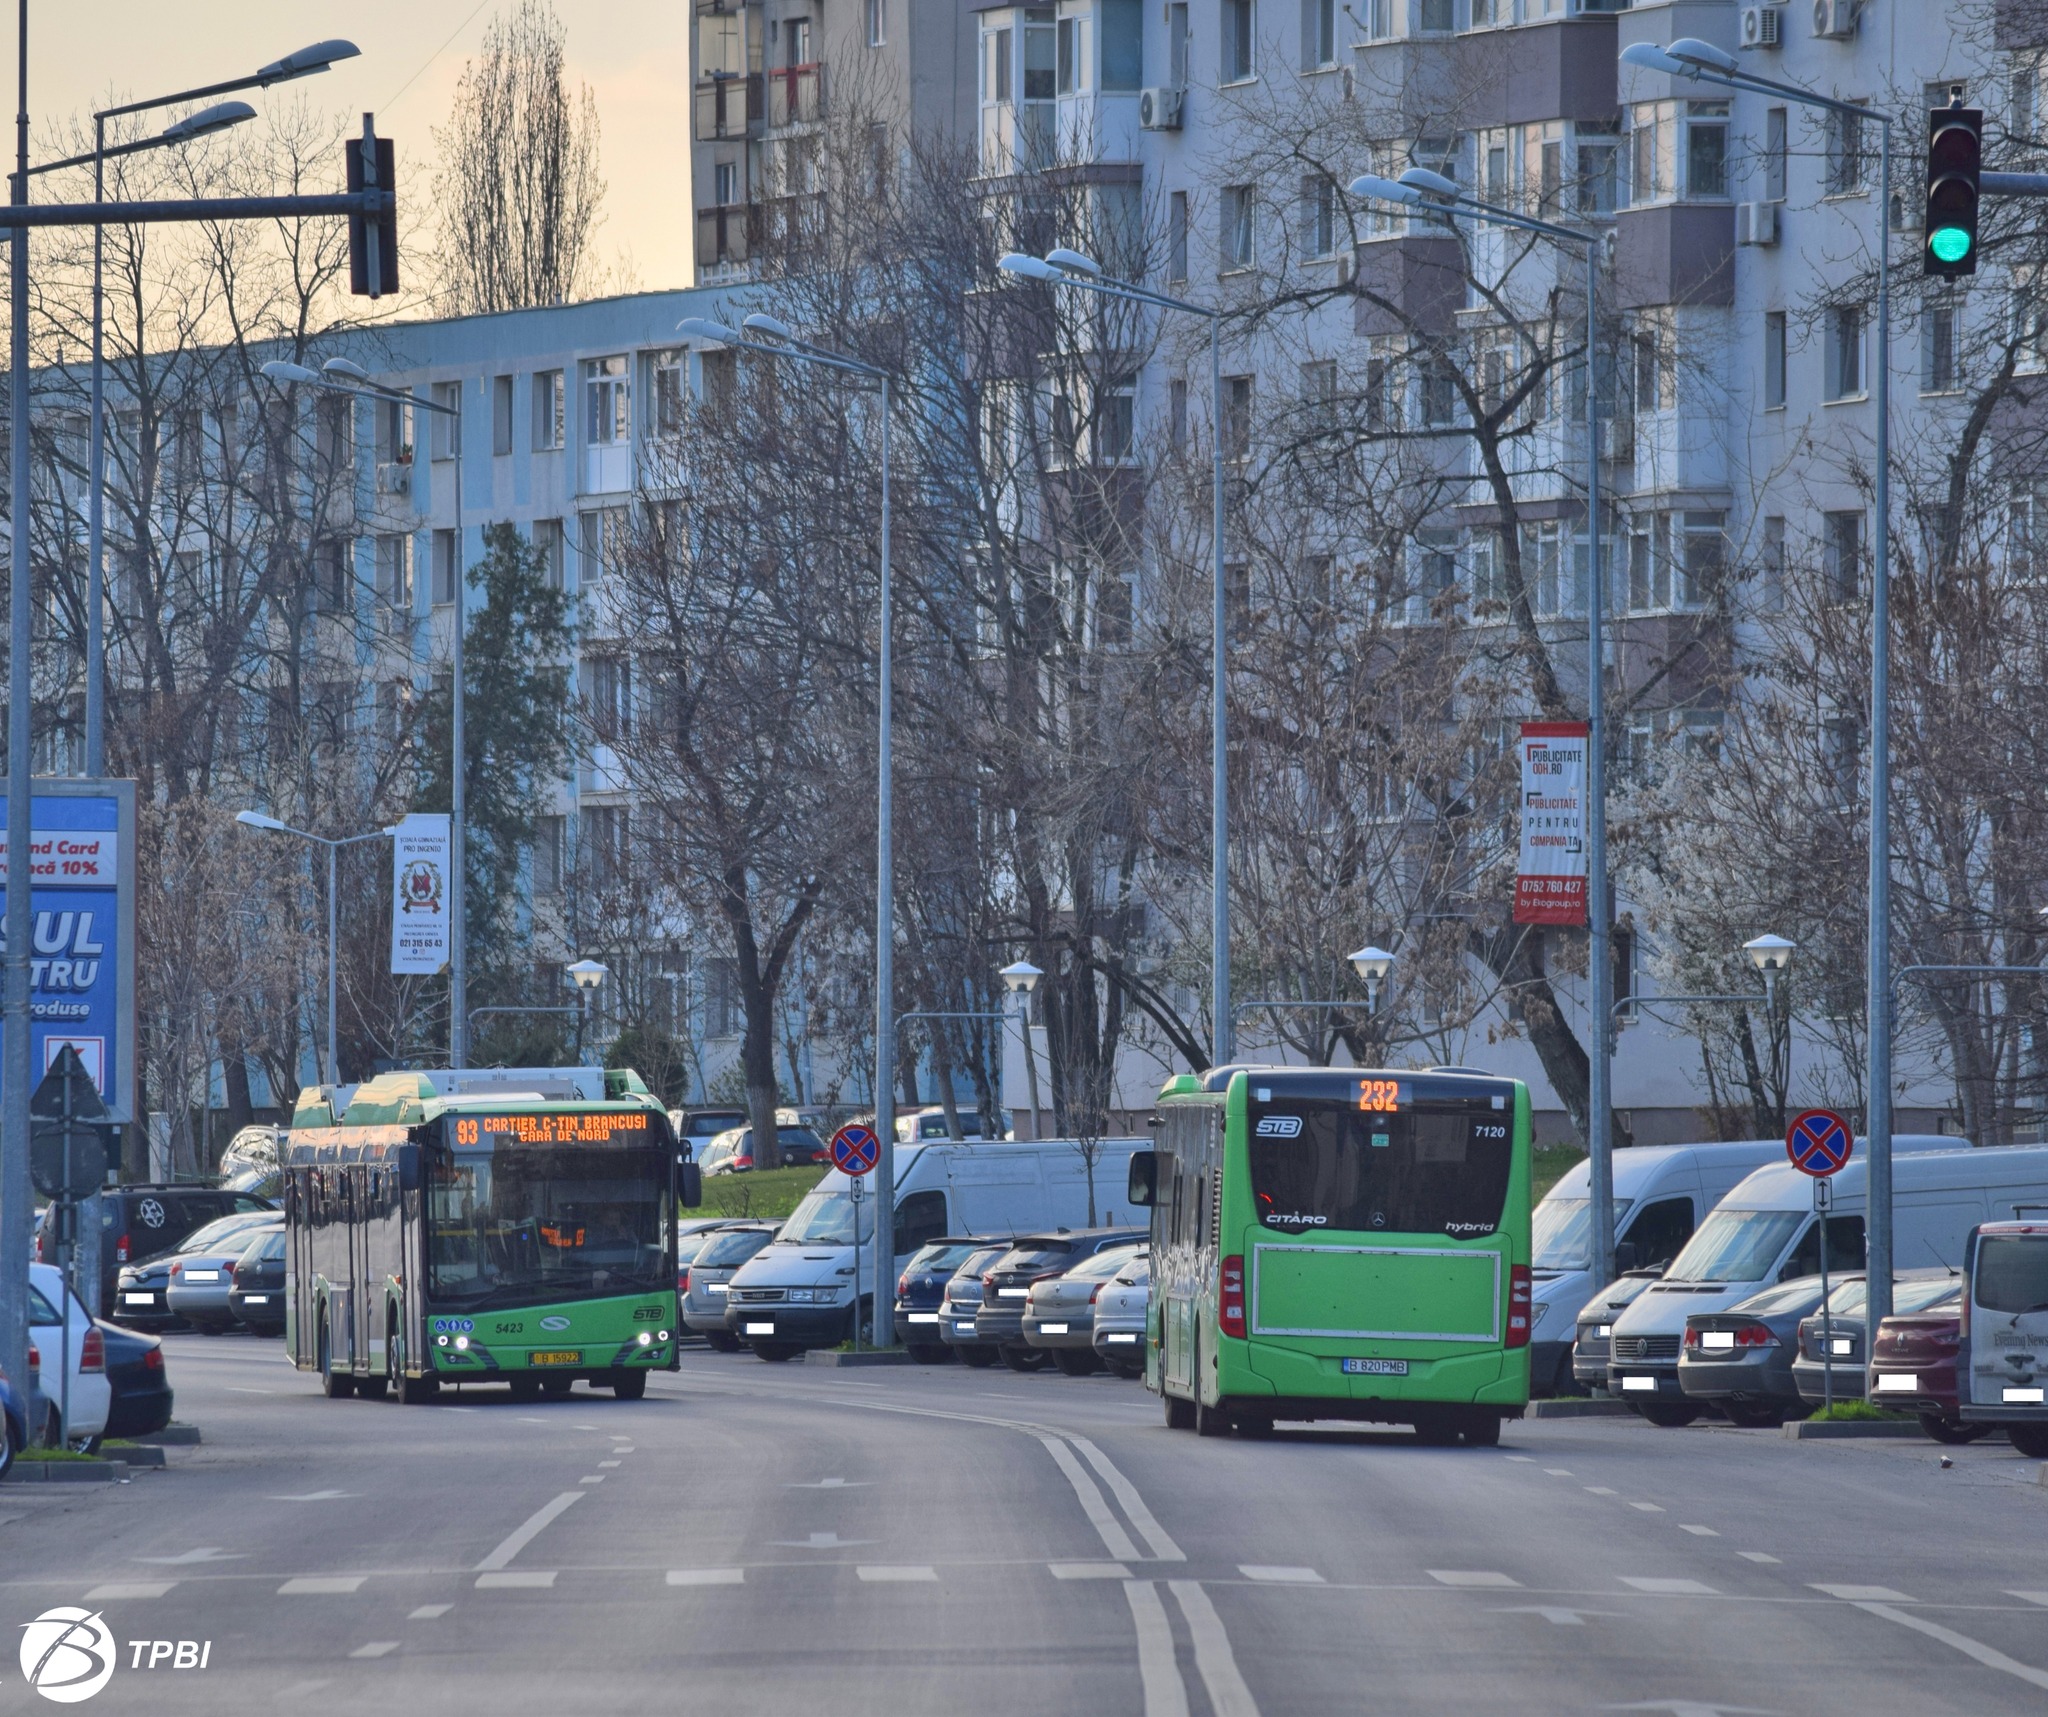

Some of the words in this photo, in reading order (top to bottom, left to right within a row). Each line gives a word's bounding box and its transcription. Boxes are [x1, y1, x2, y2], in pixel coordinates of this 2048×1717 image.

[1532, 750, 1582, 762] PUBLICITATE
[1532, 763, 1562, 775] OOH.RO
[1529, 799, 1578, 809] PUBLICITATE
[1529, 817, 1578, 828] PENTRU
[57, 841, 100, 855] Card
[1530, 836, 1567, 847] COMPANIA
[1568, 836, 1578, 847] TA
[61, 861, 98, 875] 10%
[1522, 880, 1544, 892] 0752
[1546, 881, 1562, 893] 760
[1564, 881, 1581, 893] 427
[1520, 899, 1531, 908] by
[1, 911, 103, 954] UL
[1360, 1080, 1398, 1112] 232
[484, 1117, 536, 1132] CARTIER
[543, 1116, 578, 1131] C-TIN
[584, 1115, 646, 1130] BRANCUSI
[1256, 1118, 1301, 1136] STB
[457, 1119, 478, 1145] 93
[520, 1131, 552, 1142] GARA
[558, 1130, 573, 1142] DE
[578, 1129, 610, 1141] NORD
[1475, 1125, 1505, 1138] 7120
[1445, 1222, 1494, 1233] hybrid
[632, 1307, 664, 1320] STB
[496, 1322, 523, 1334] 5423
[1994, 1333, 2025, 1349] Evening
[542, 1354, 549, 1363] B
[553, 1351, 578, 1363] 15922
[1349, 1360, 1357, 1370] B
